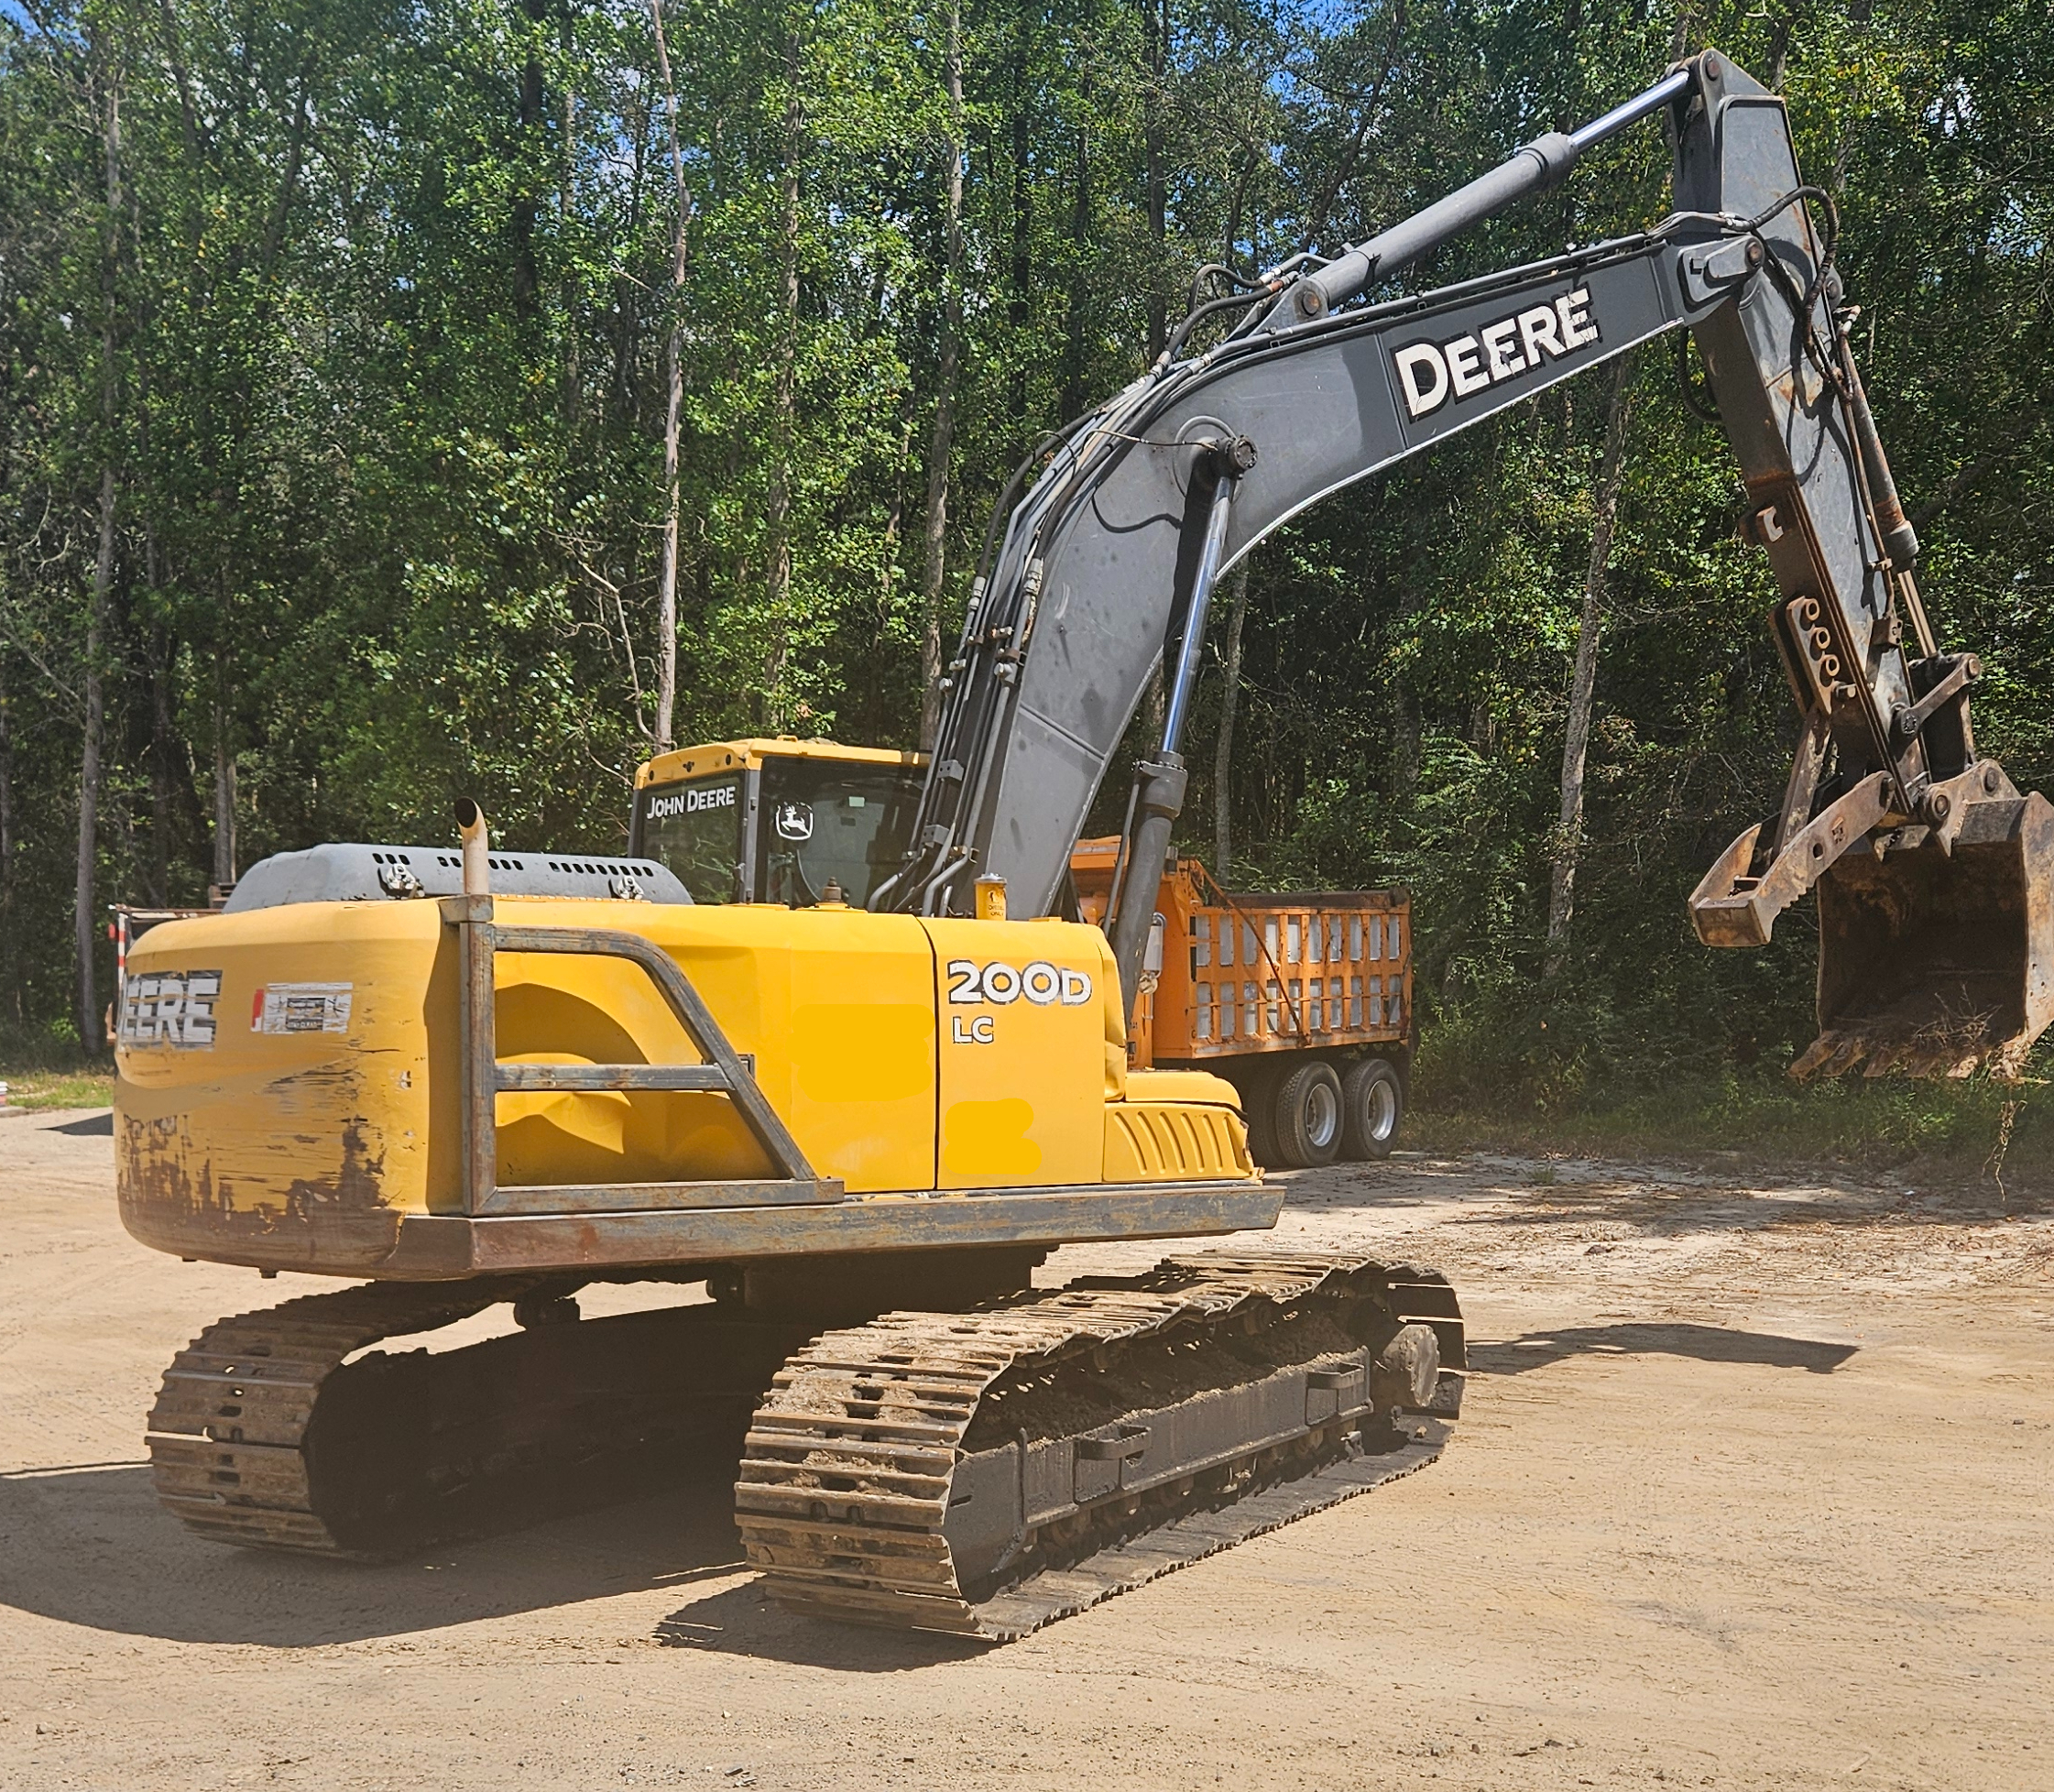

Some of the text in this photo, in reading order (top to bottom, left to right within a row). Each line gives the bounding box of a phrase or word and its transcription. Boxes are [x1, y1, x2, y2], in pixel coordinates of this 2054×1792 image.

[1393, 284, 1601, 421] DEERE
[647, 786, 736, 820] JOHN DEERE
[947, 959, 1092, 1005] 200D
[953, 1016, 994, 1044] LC
